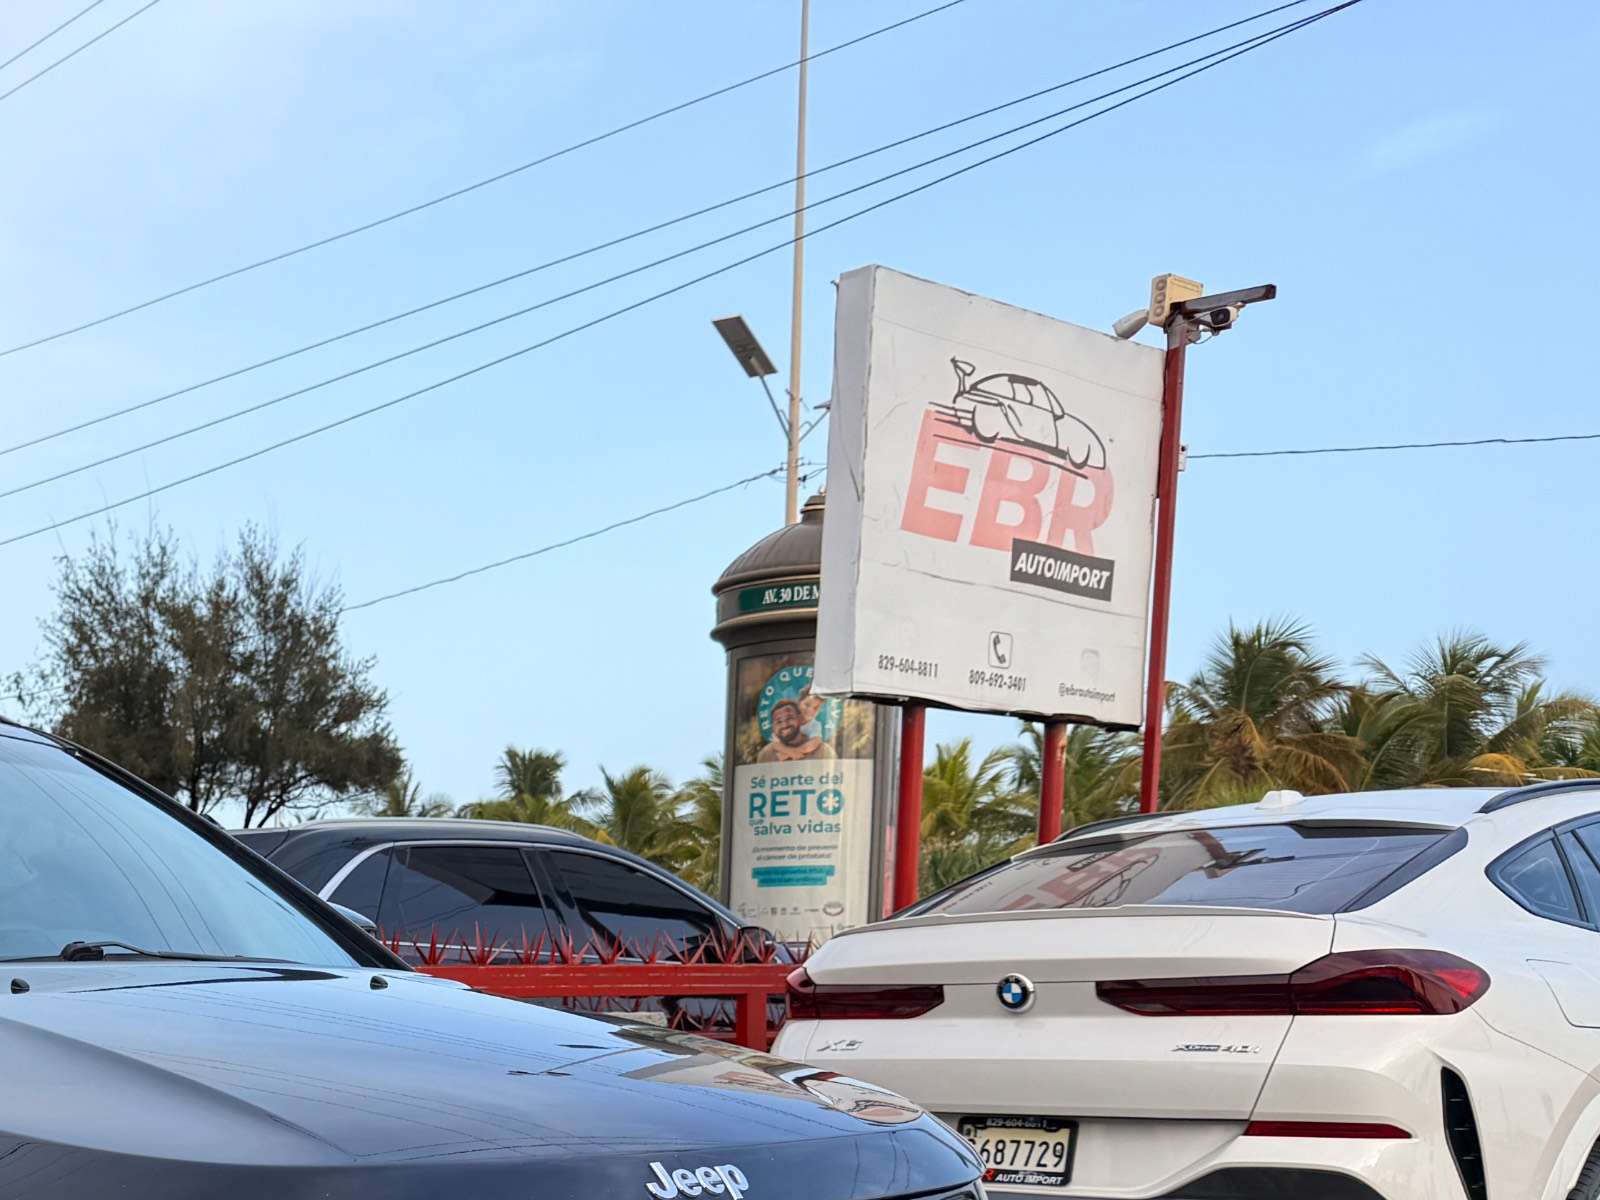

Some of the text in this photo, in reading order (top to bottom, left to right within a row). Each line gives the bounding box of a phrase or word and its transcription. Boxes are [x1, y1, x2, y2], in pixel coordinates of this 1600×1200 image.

[900, 409, 1114, 554] EBR
[1013, 551, 1112, 590] AUTOIMPORT
[762, 588, 778, 605] AV.
[778, 587, 792, 603] 30
[794, 585, 811, 601] DE
[878, 654, 938, 679] 829-604-8811
[968, 669, 1027, 692] 809-692-3401
[770, 774, 814, 789] parte
[819, 771, 844, 785] del
[749, 789, 845, 819] RETO
[753, 819, 842, 836] salva vidas
[646, 1161, 749, 1200] Jeep
[995, 1173, 1024, 1183] AUTO
[1024, 1174, 1063, 1185] IMPORT
